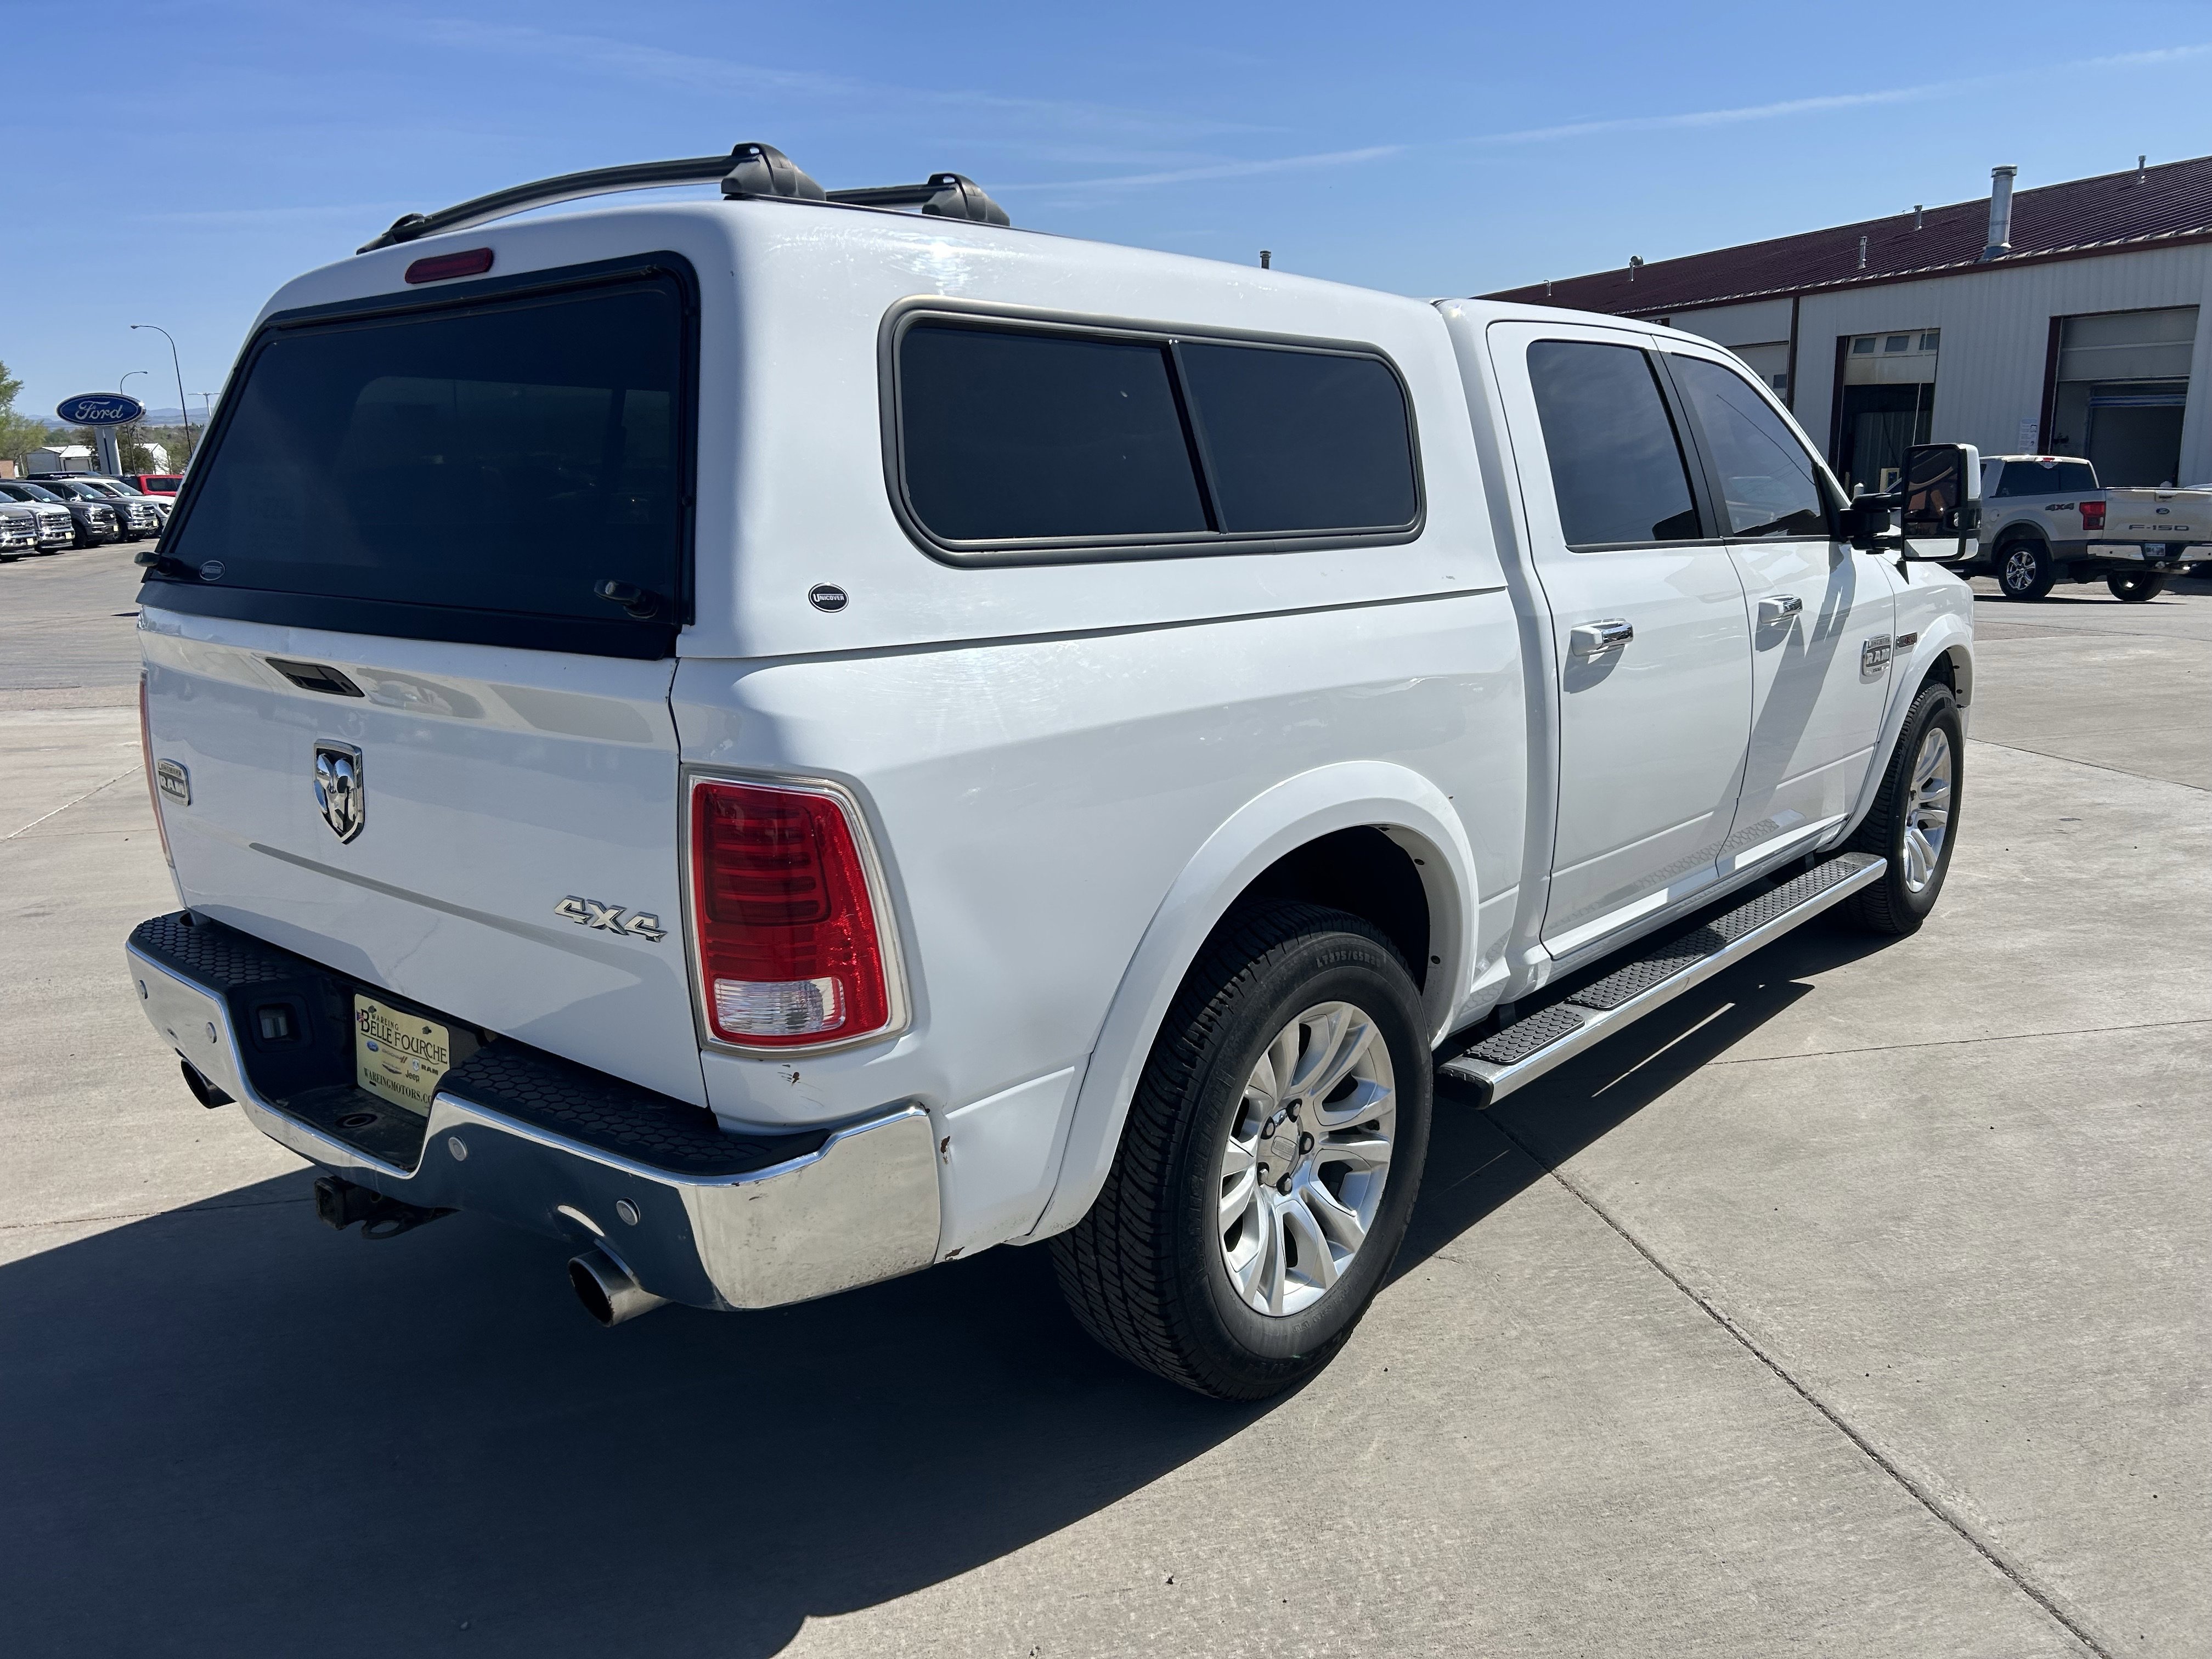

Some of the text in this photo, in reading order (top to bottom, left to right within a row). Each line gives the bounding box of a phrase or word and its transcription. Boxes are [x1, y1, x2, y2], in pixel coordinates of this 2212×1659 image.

[75, 400, 123, 420] Ford
[1865, 648, 1890, 665] RAM
[159, 775, 185, 795] RAM
[371, 1013, 399, 1031] WAREING
[360, 1008, 448, 1065] BELLE FOURCHE
[405, 1070, 420, 1083] Jeep
[421, 1064, 439, 1075] RAM
